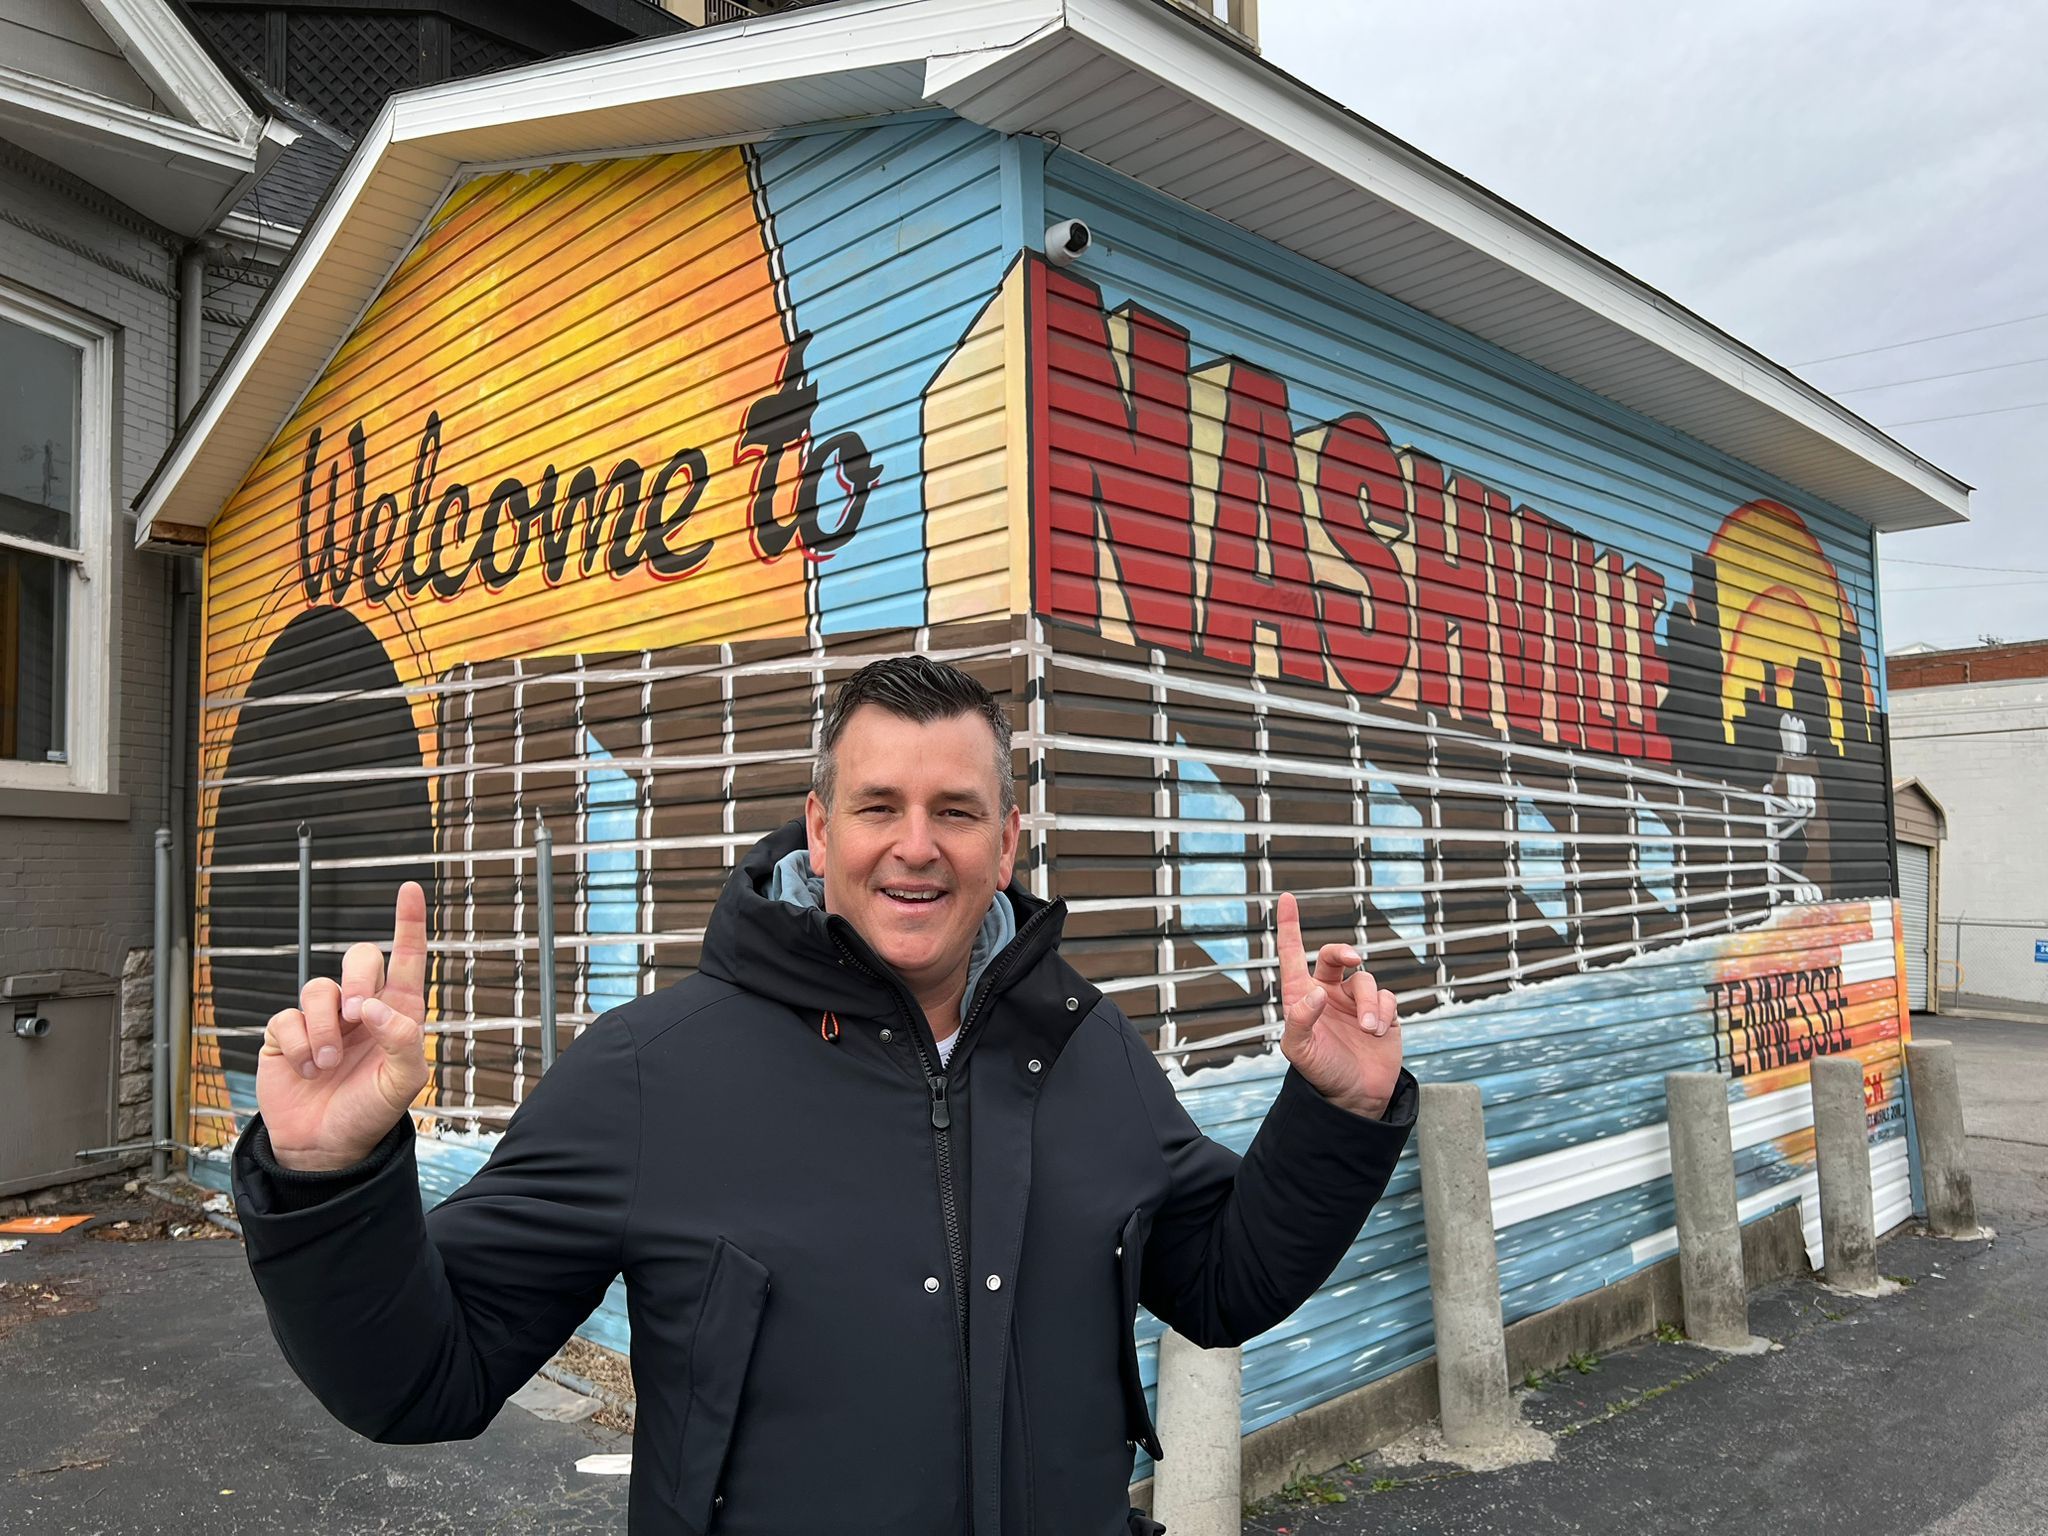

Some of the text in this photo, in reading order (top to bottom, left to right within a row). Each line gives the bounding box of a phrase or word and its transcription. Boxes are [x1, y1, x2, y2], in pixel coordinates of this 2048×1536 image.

[297, 330, 884, 609] Welcome to
[1029, 249, 1673, 764] NASHVILLE
[1705, 966, 1853, 1079] TENNESSEE
